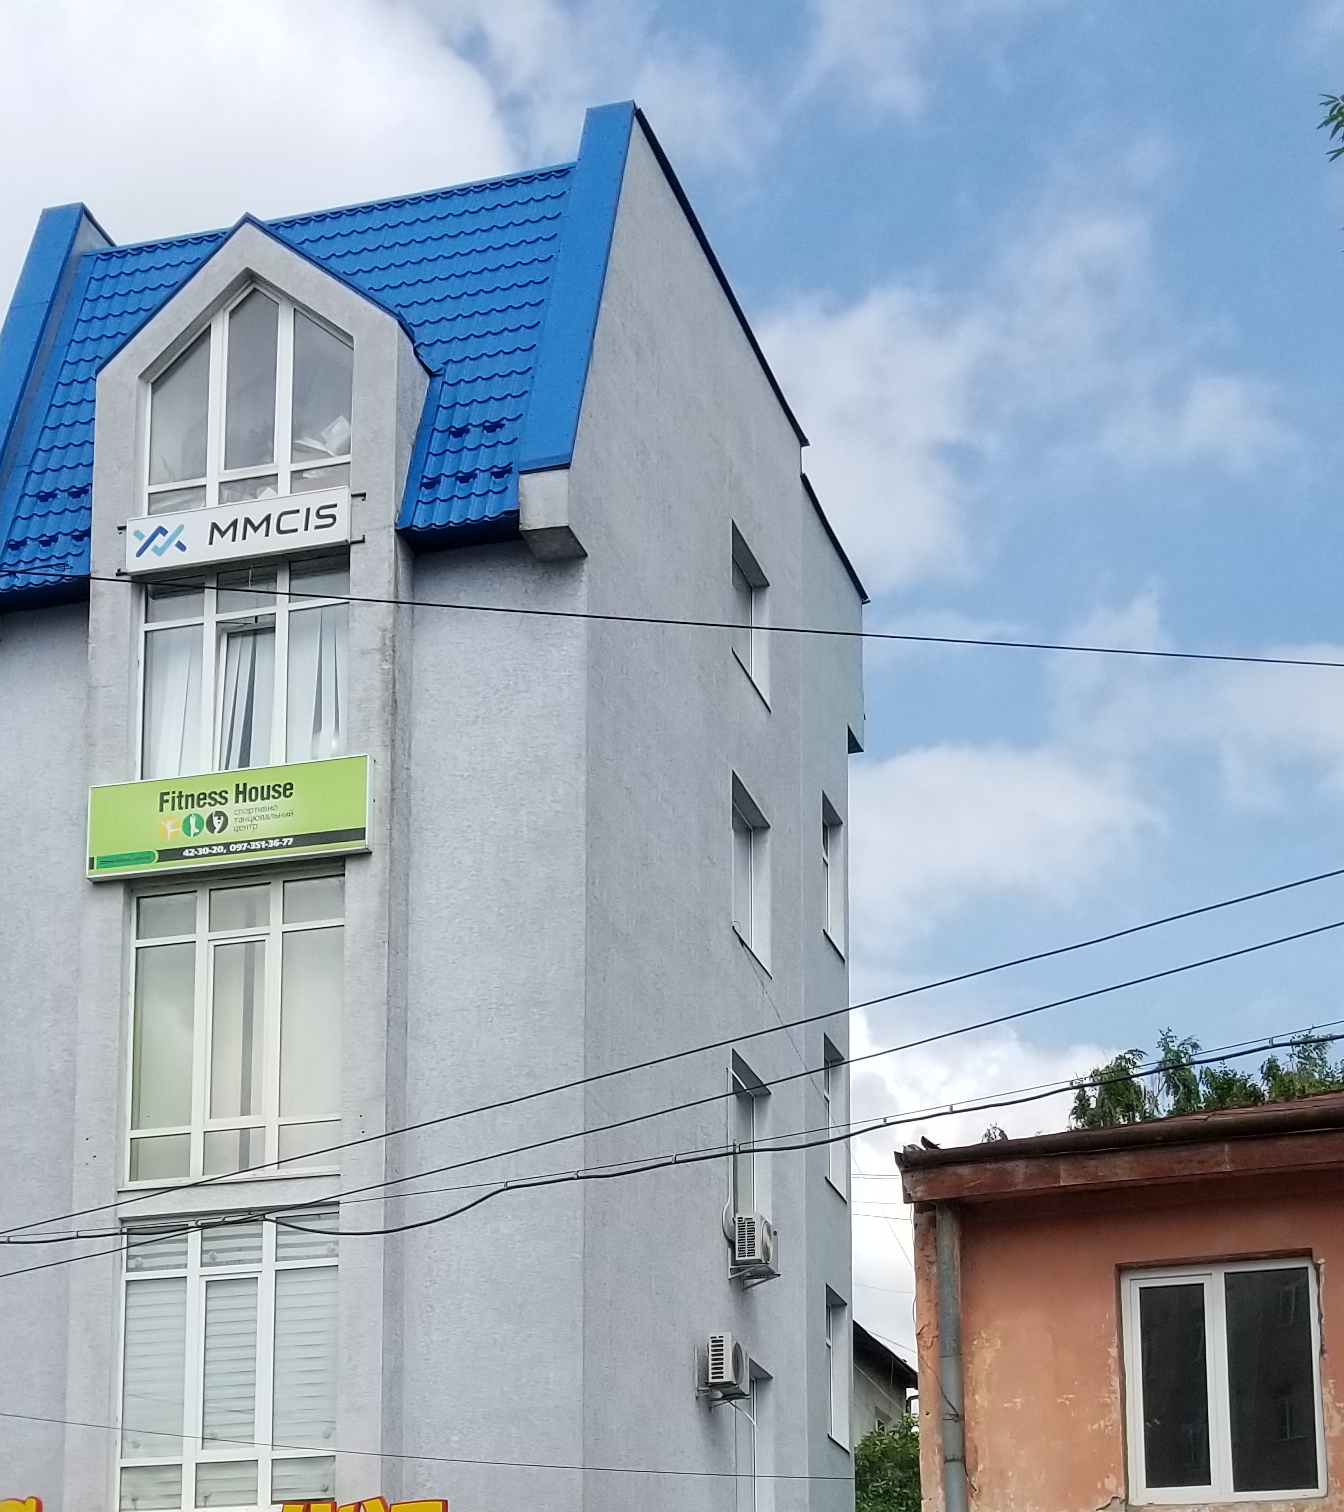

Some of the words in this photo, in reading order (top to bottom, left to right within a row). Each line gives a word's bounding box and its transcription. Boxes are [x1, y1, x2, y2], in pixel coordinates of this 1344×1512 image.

[208, 503, 338, 546] MMCIS
[159, 788, 229, 812] Fitness
[234, 781, 294, 804] House
